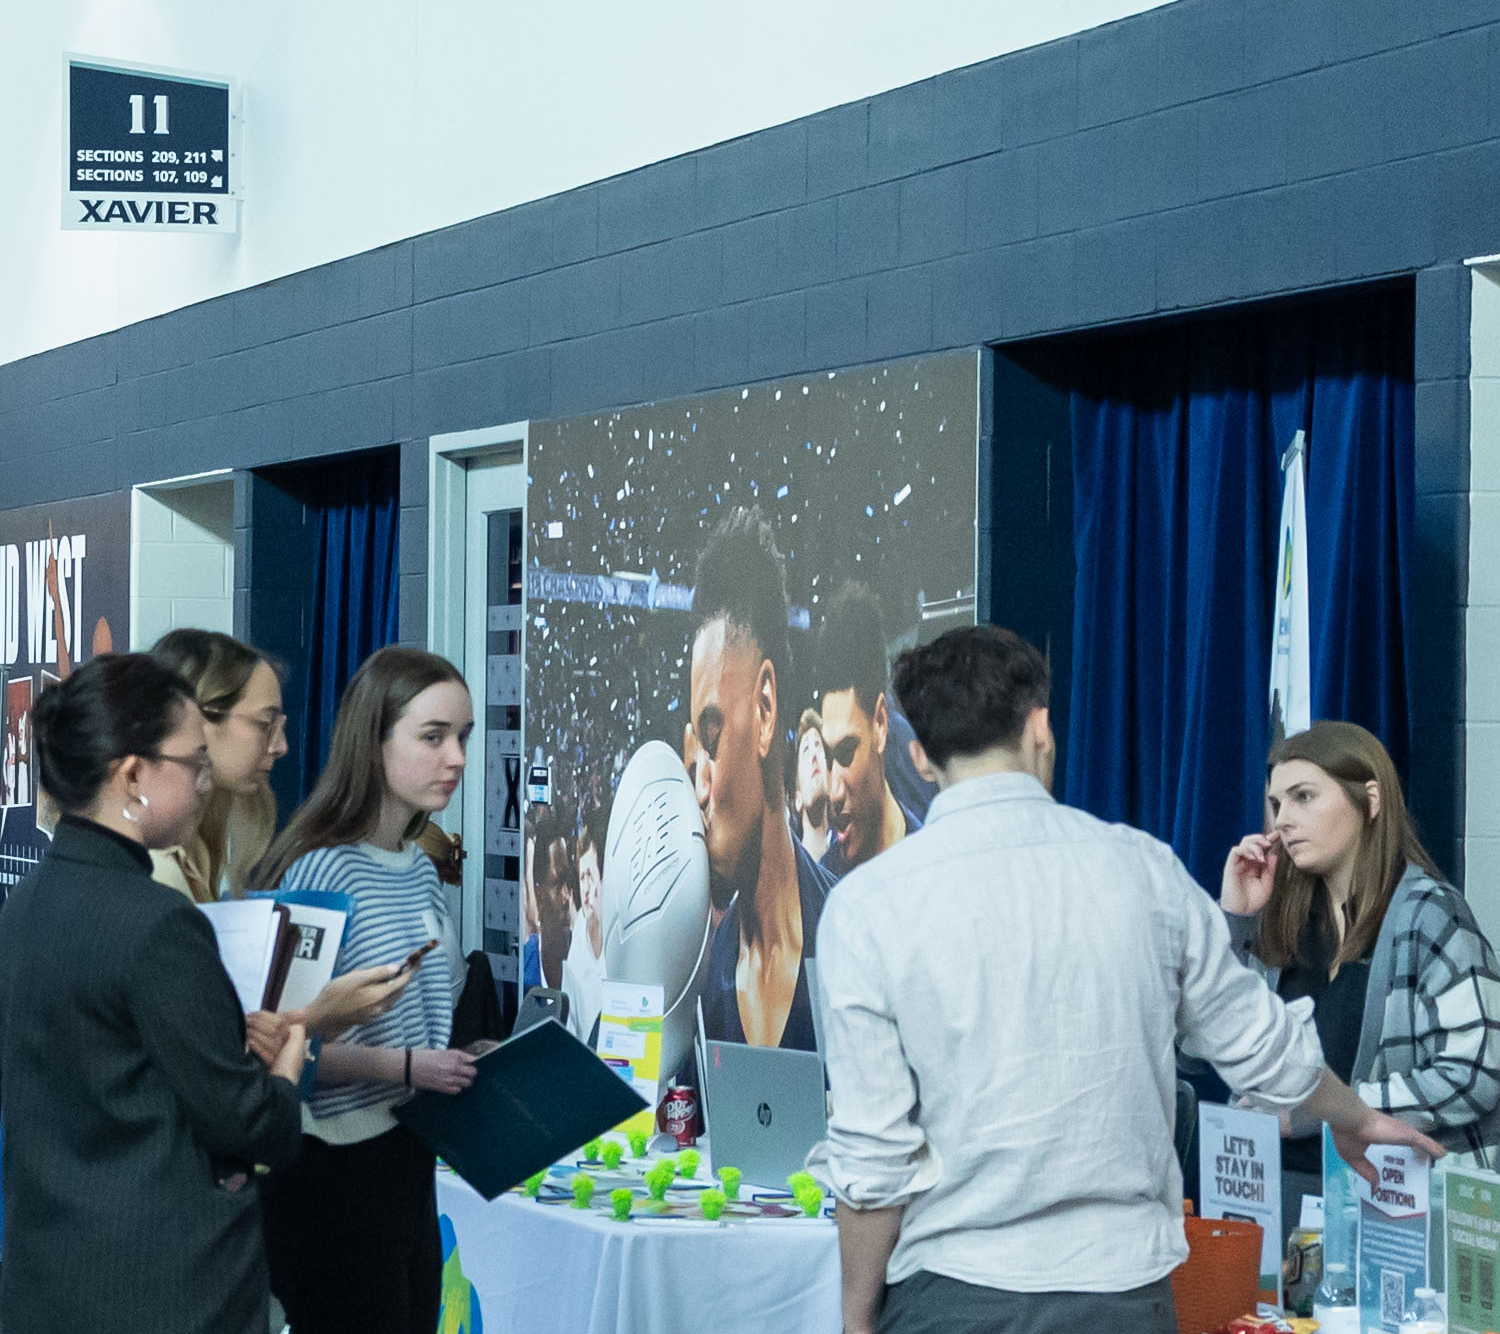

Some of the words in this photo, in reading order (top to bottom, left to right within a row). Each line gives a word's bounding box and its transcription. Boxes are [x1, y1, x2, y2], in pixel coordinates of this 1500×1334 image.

[129, 94, 170, 135] 11
[77, 149, 144, 163] SECTIONS
[152, 151, 180, 165] 209,
[184, 152, 207, 164] 211
[77, 169, 144, 182] SECTIONS
[152, 170, 179, 184] 107,
[184, 171, 208, 183] 109
[78, 199, 219, 225] XAVIER
[25, 534, 86, 664] WEST
[1223, 1134, 1256, 1157] LET'S
[1215, 1155, 1246, 1179] STAY
[1250, 1162, 1264, 1181] IN
[1382, 1167, 1406, 1185] OPEN
[1215, 1177, 1265, 1202] TOUCH!
